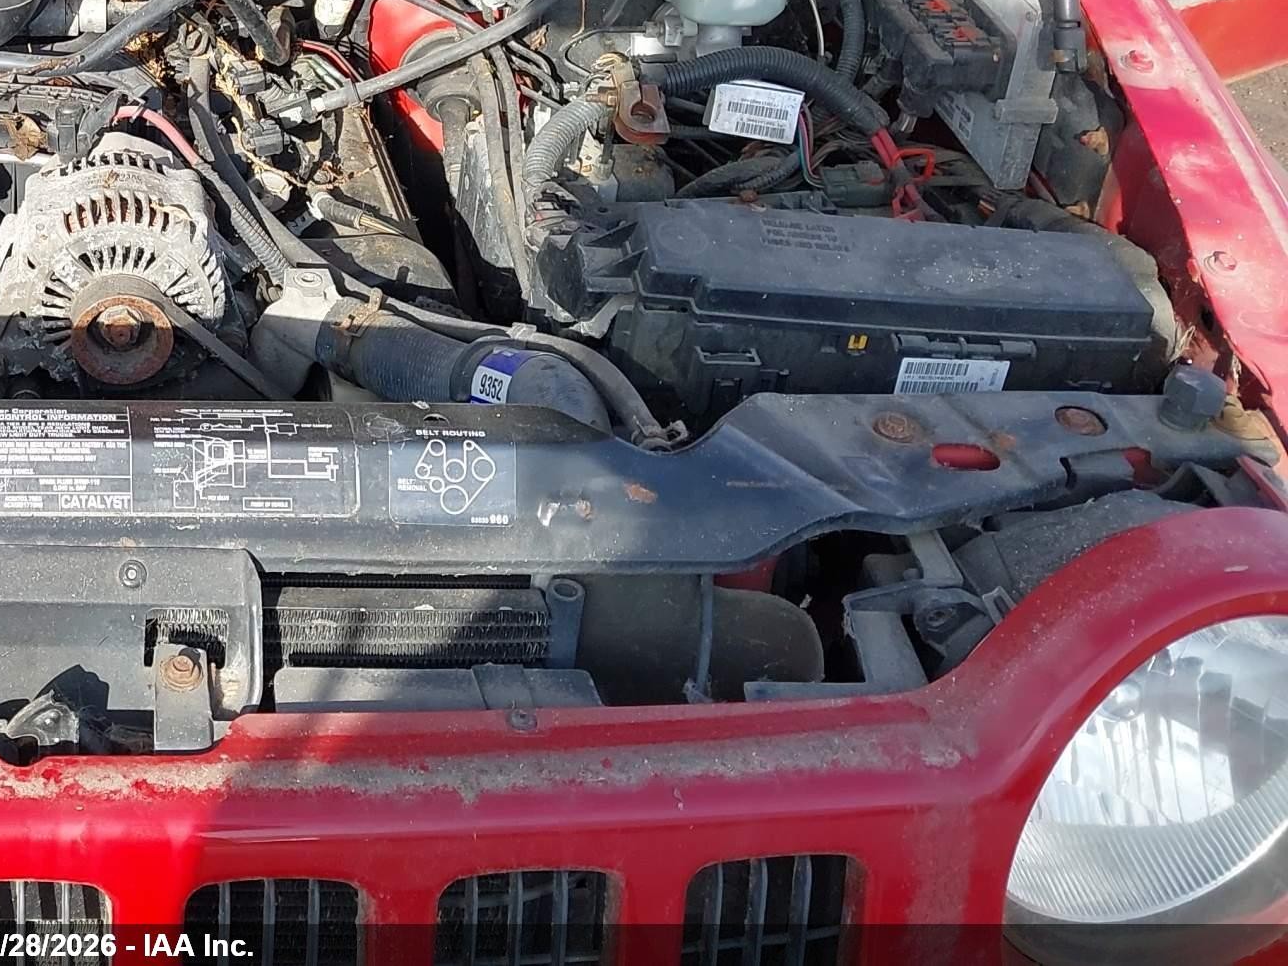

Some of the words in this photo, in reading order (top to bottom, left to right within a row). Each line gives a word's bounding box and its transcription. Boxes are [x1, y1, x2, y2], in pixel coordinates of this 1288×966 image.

[479, 373, 504, 401] 9352
[46, 413, 117, 421] INFORMATION
[441, 429, 487, 437] ROUTING
[61, 494, 132, 509] CATALYST
